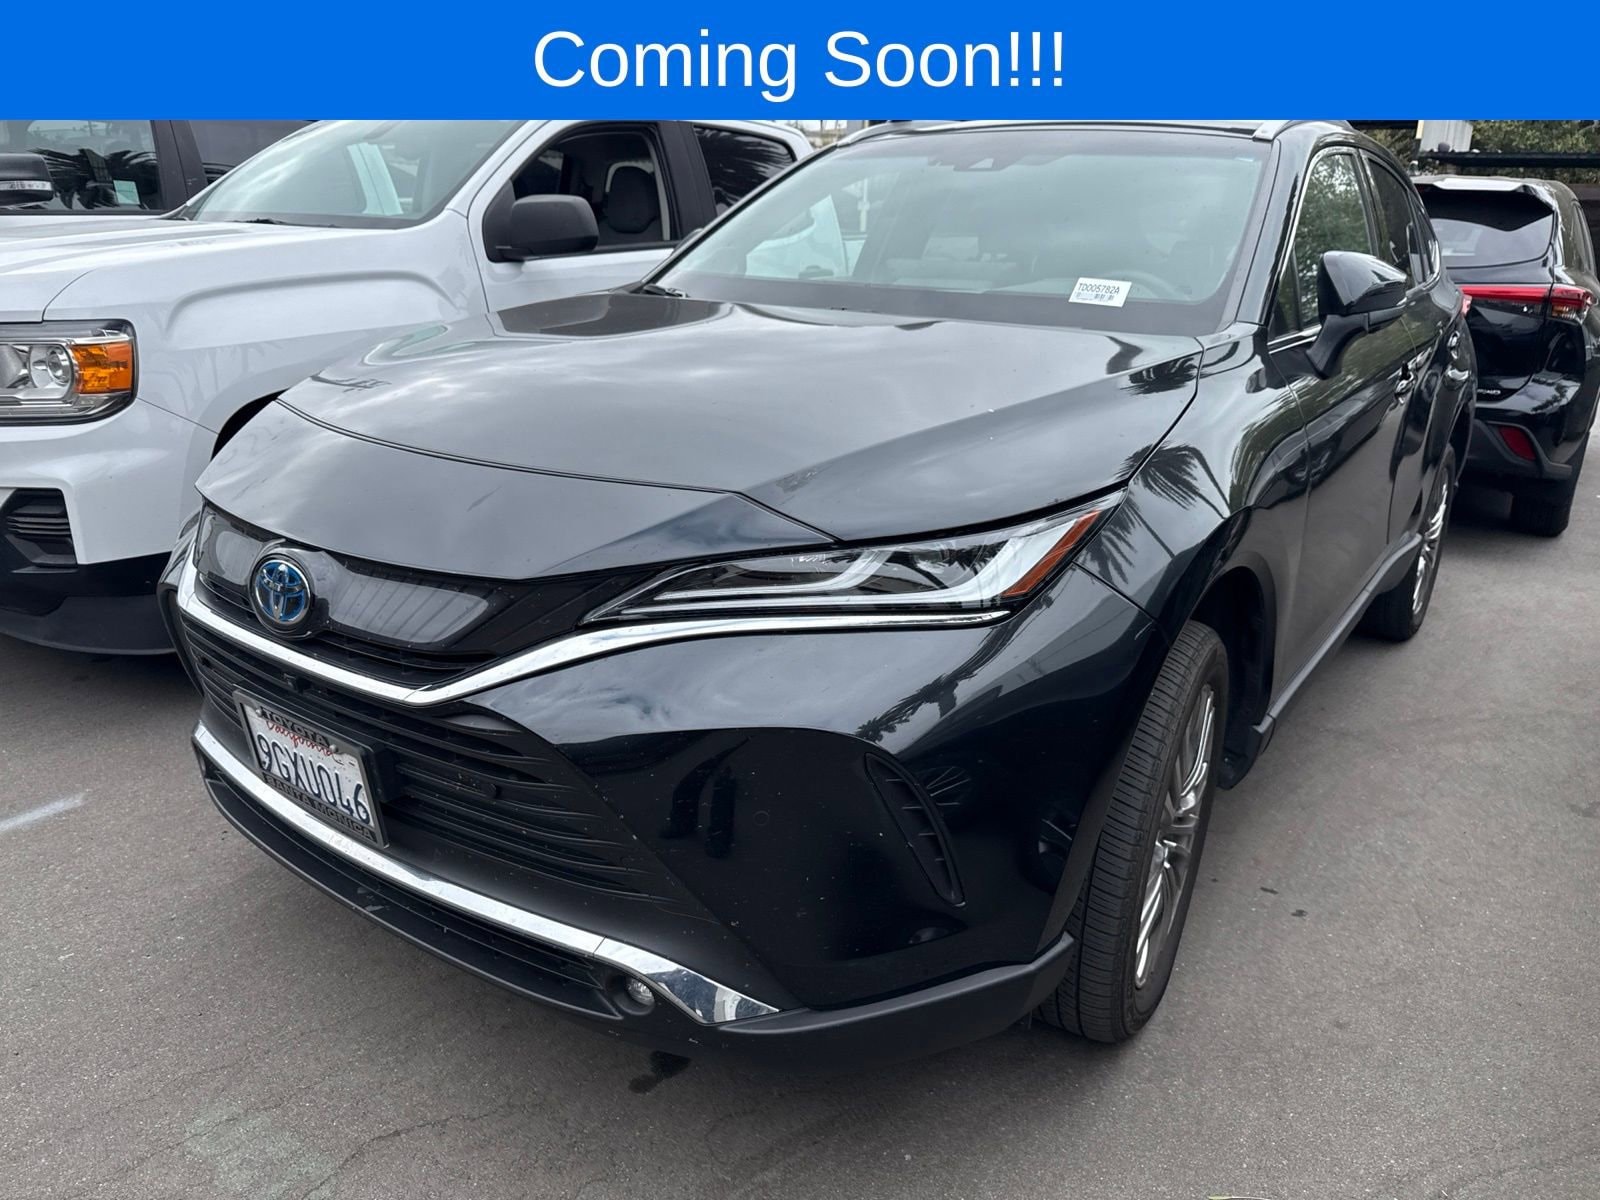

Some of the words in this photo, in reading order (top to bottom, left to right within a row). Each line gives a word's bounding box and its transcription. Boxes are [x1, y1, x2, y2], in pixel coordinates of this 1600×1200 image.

[263, 707, 331, 748] TOYOTA
[256, 734, 371, 826] 9GXU046
[265, 774, 311, 805] SANTA
[315, 802, 375, 841] MONICA
